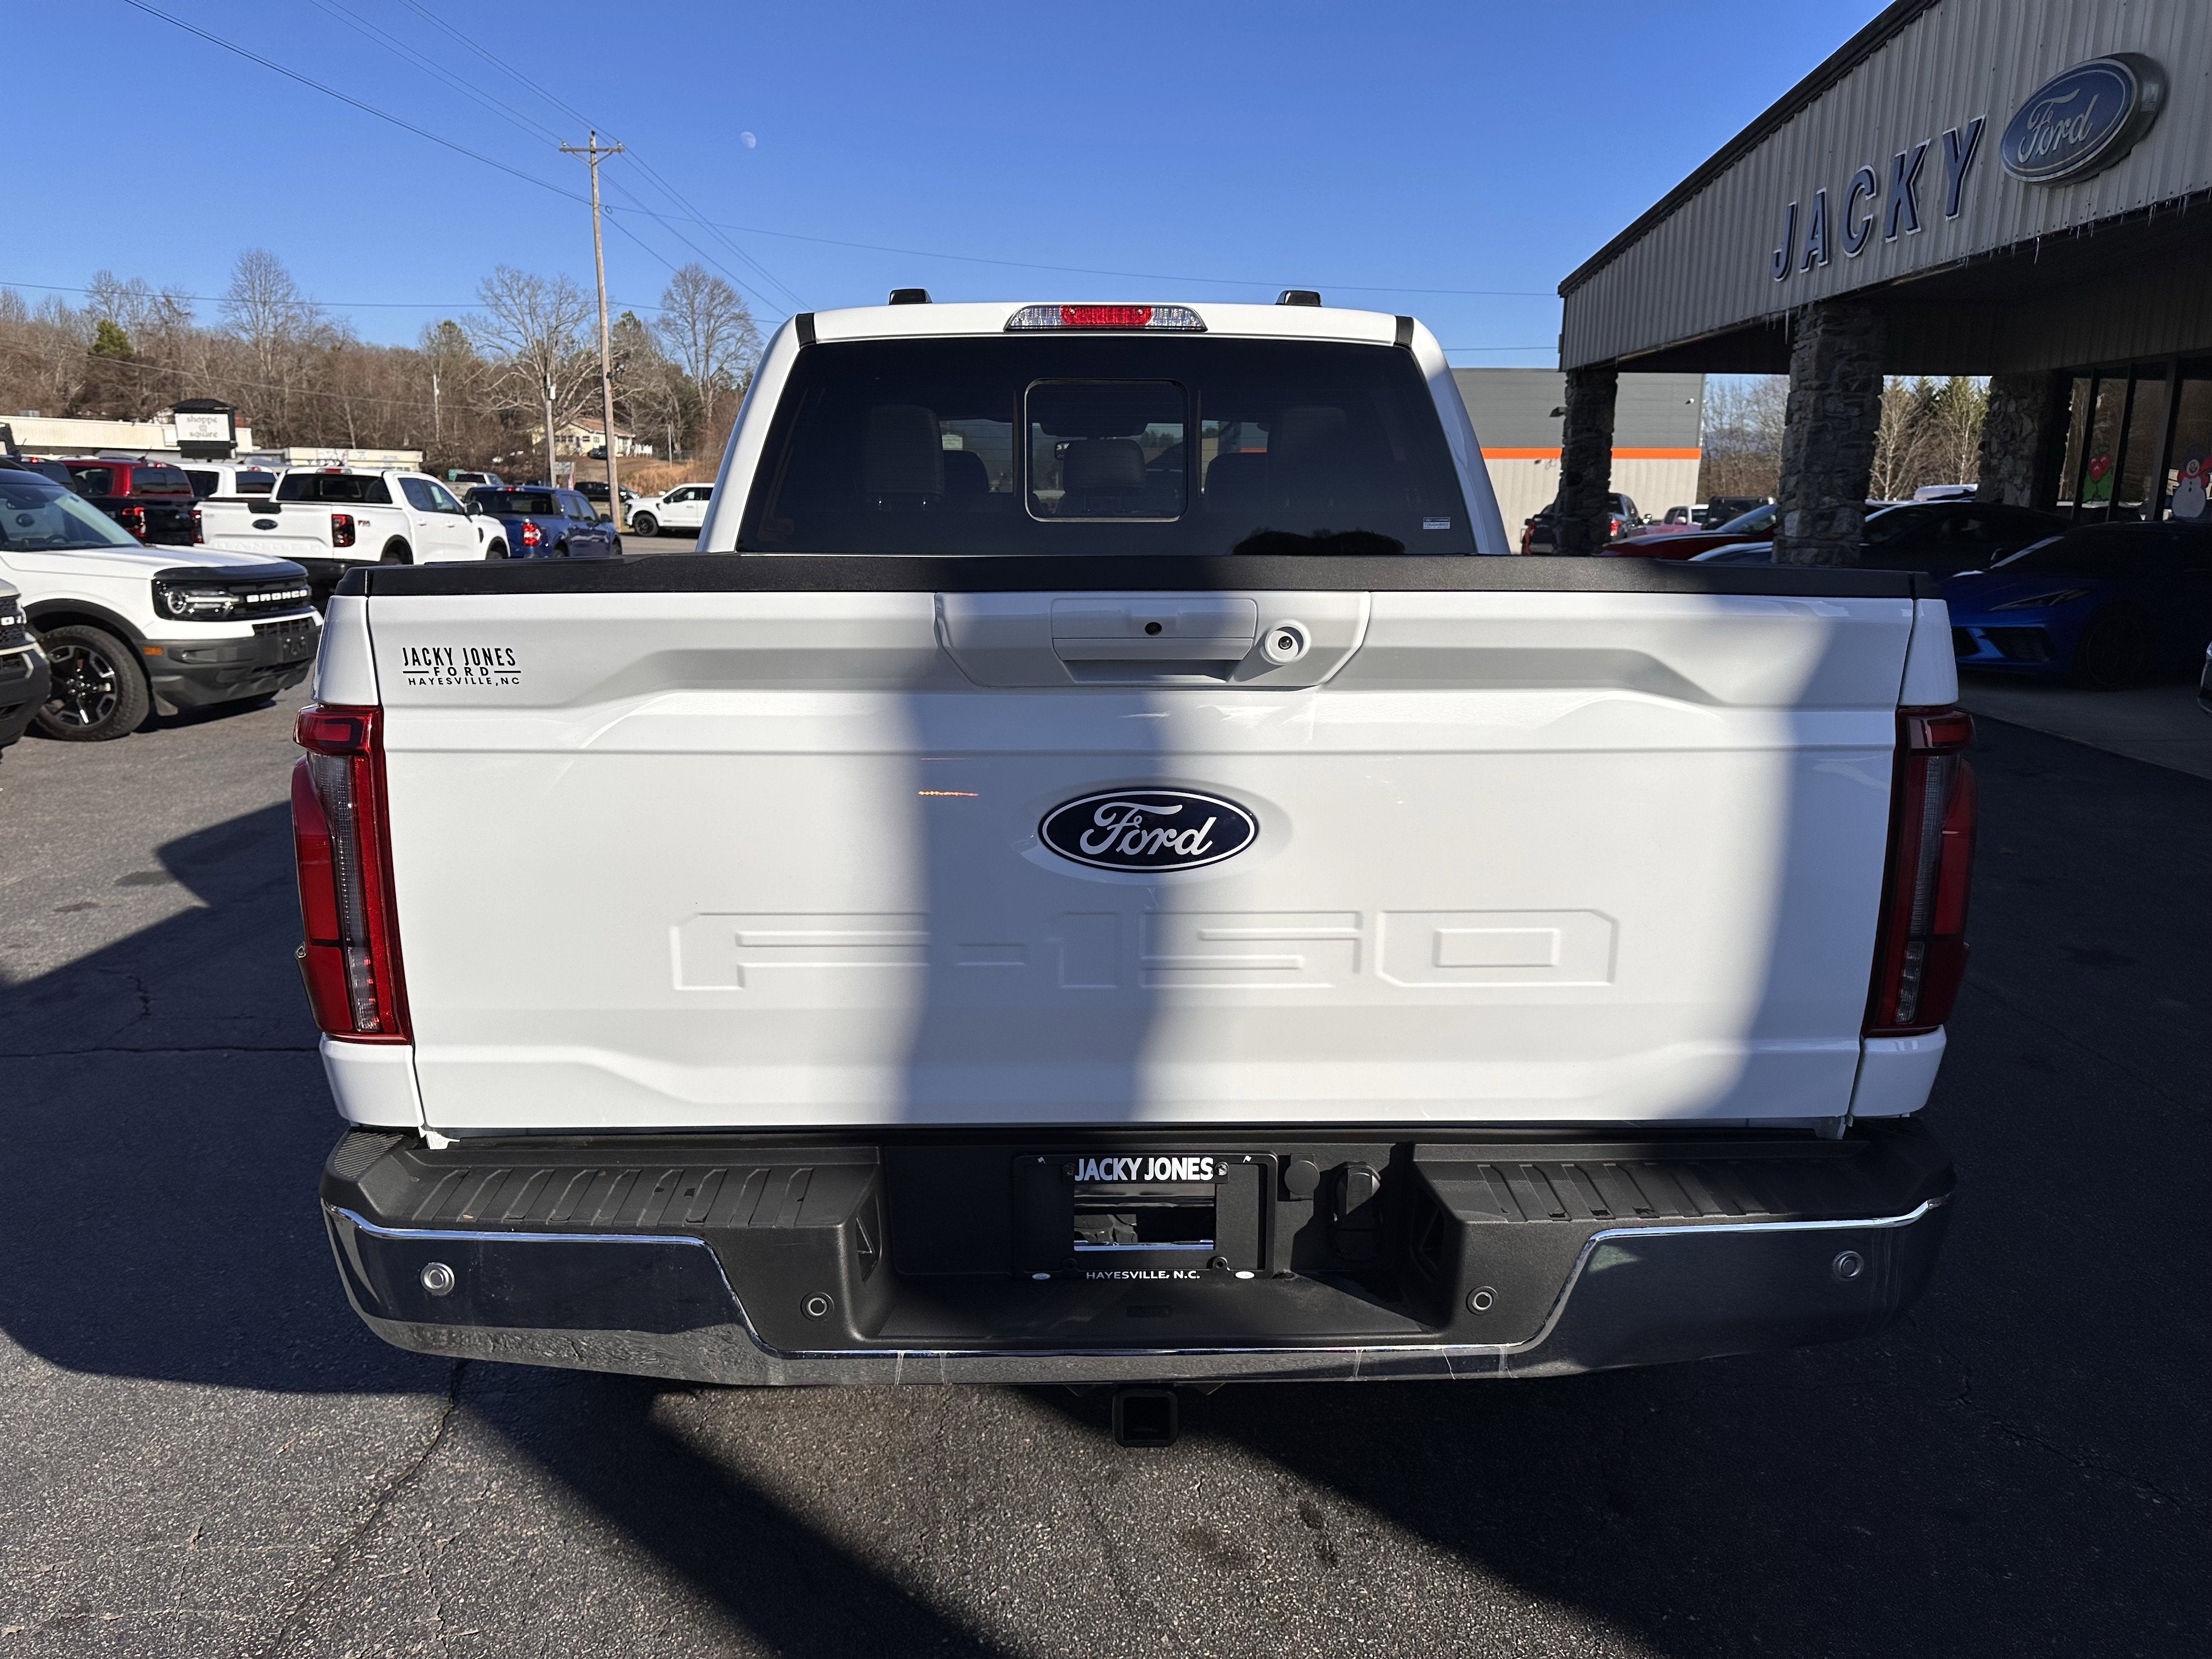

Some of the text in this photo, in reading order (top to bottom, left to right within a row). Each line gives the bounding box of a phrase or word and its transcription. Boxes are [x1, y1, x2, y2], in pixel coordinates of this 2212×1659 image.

[2017, 88, 2099, 163] Ford
[1771, 114, 1985, 282] JACKY
[403, 647, 516, 666] JACKY JONES
[433, 667, 489, 676] FORD
[1080, 802, 1217, 855] Ford
[669, 909, 1618, 991] F-150
[1075, 1157, 1214, 1181] JACKY JONES
[1086, 1271, 1200, 1279] HAYESVILLE, N.C.
